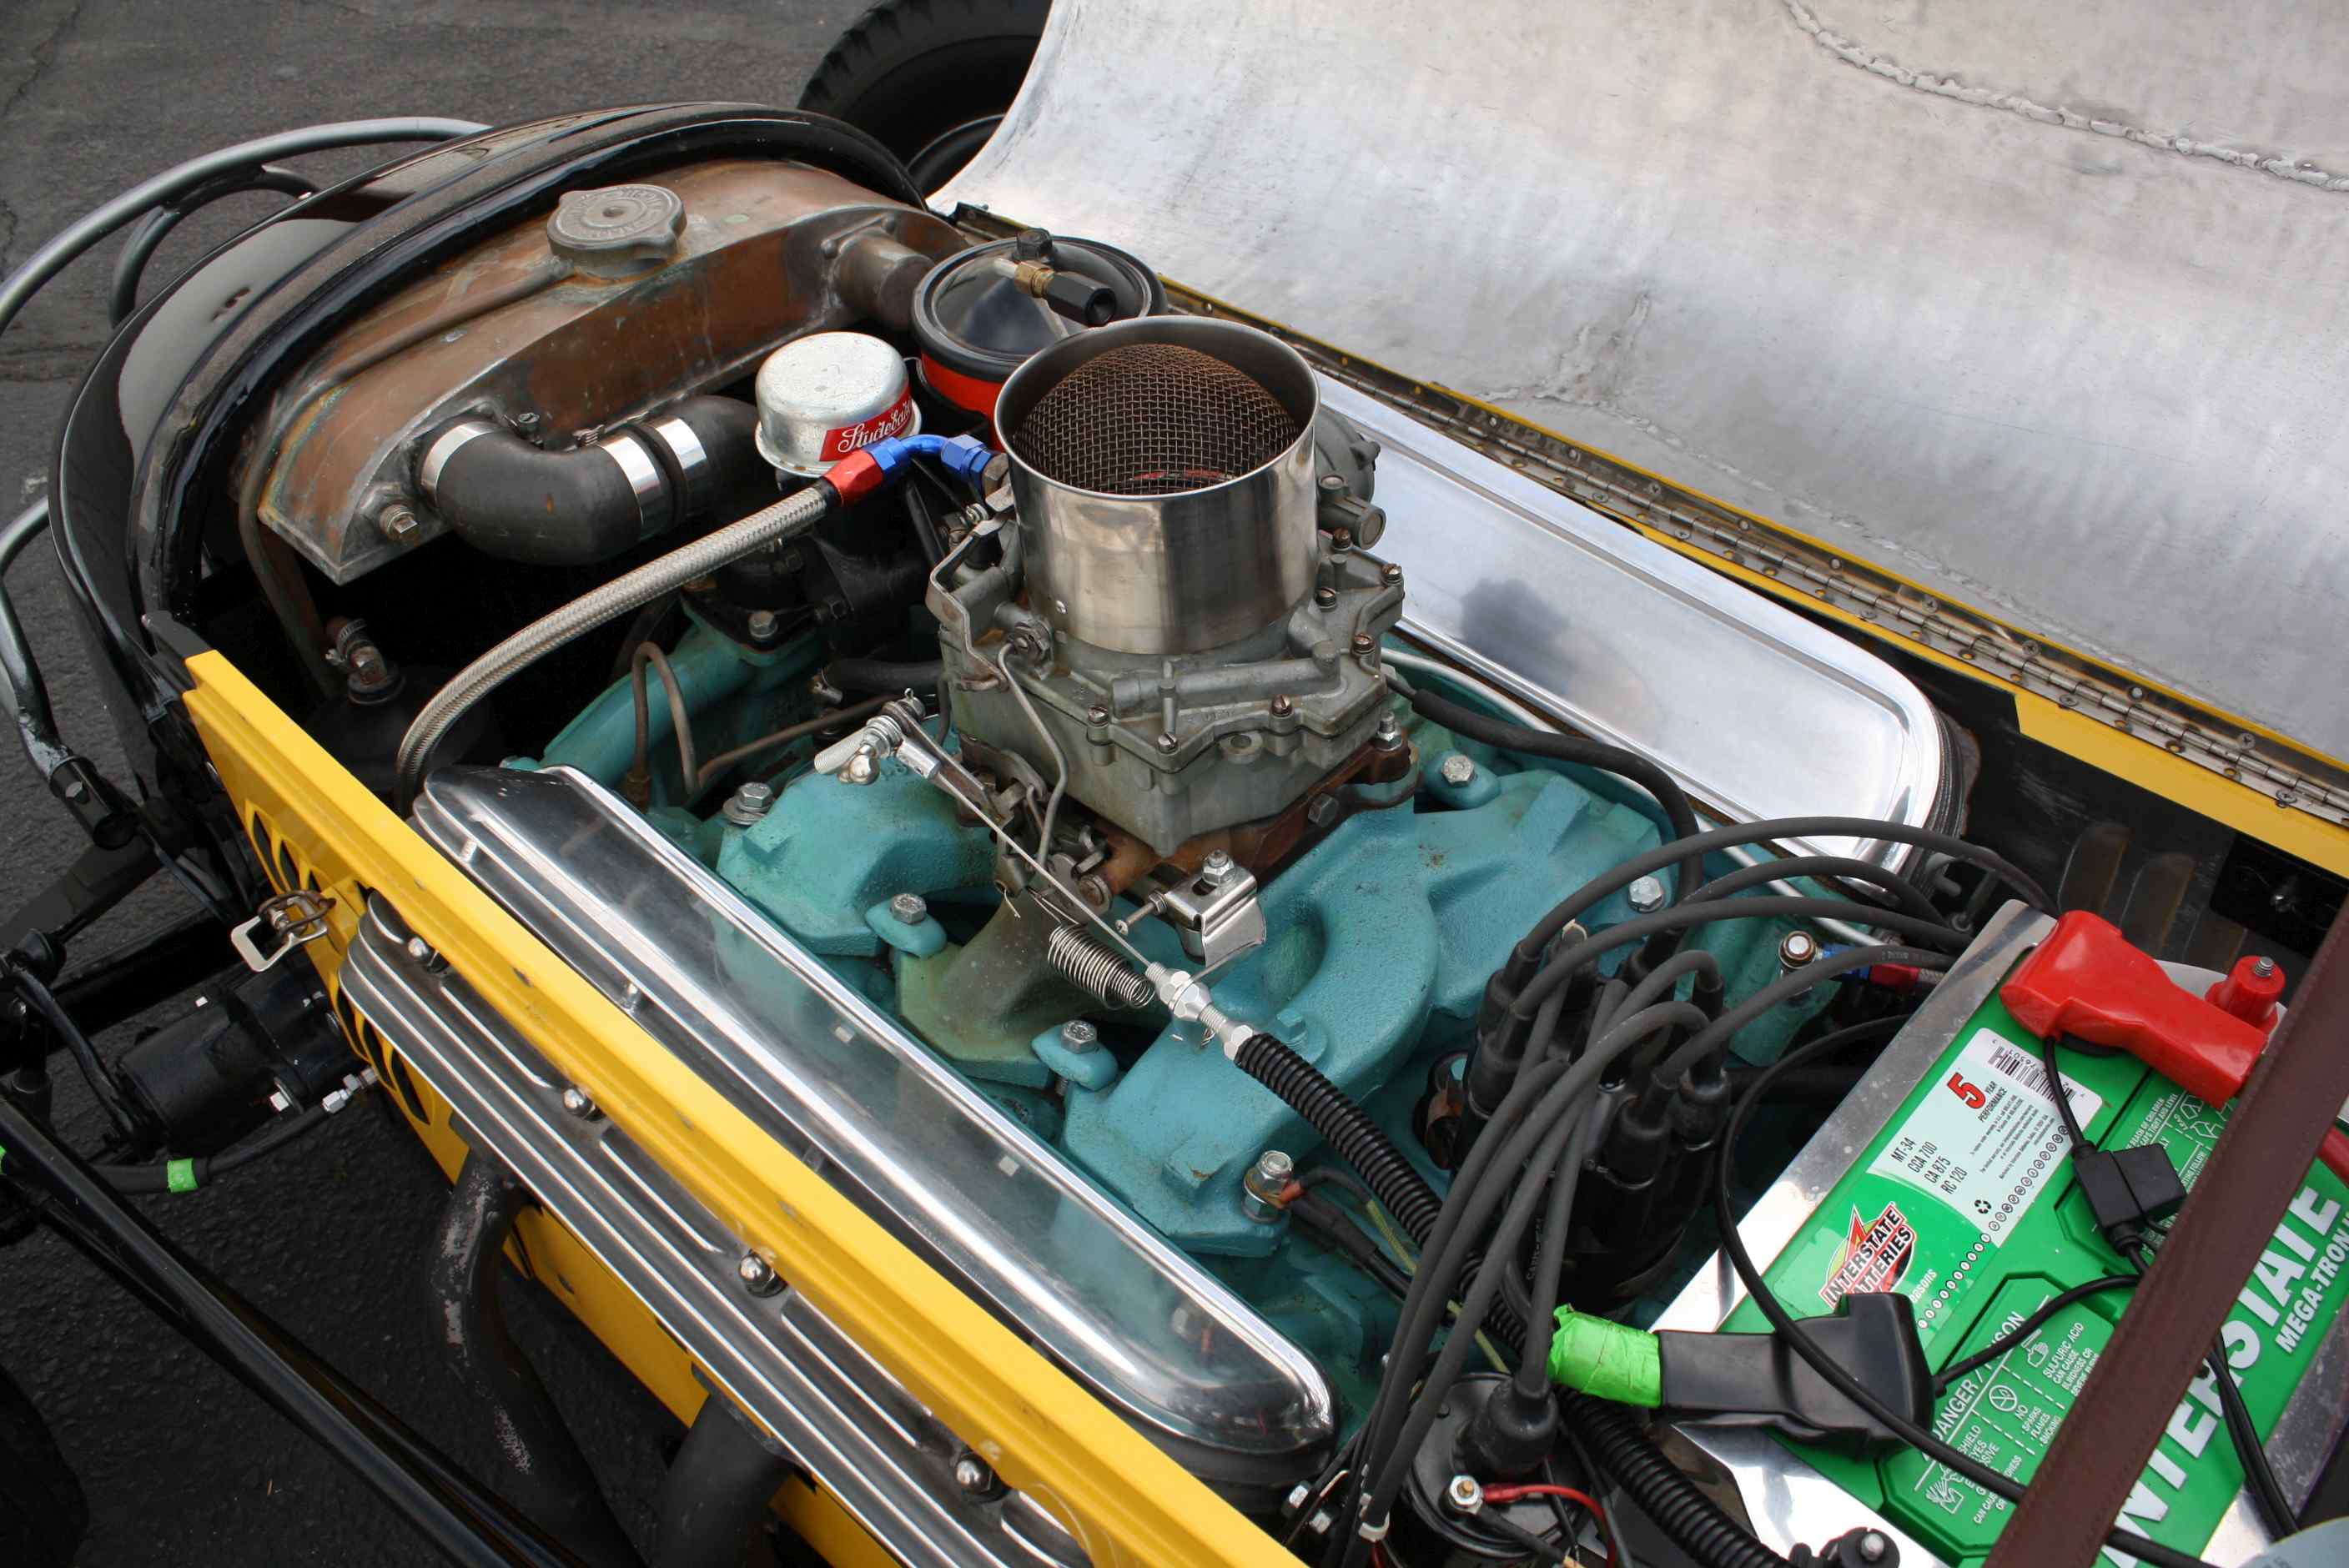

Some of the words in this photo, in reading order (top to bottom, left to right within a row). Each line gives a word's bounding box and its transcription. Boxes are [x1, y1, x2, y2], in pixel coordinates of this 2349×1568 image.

[1947, 1072, 1986, 1109] 5
[1985, 1081, 1998, 1095] YEAR
[1978, 1087, 2008, 1123] PERFORMANCE
[2145, 1098, 2164, 1122] CHILDREN
[2147, 1118, 2162, 1133] TIGHT
[2158, 1108, 2168, 1119] AND
[1891, 1137, 1916, 1163] MT-34
[1908, 1155, 1927, 1173] CCA
[1919, 1142, 1937, 1158] 700
[1924, 1170, 1940, 1184] CA
[1932, 1156, 1950, 1173] 875
[1940, 1181, 1957, 1194] RC
[1949, 1167, 1967, 1183] 120
[1824, 1209, 1900, 1303] INTERSTATE
[1854, 1226, 1912, 1294] ATTERIES
[1909, 1269, 1937, 1303] easons
[2275, 1228, 2349, 1354] MEGA-TRON
[2043, 1340, 2071, 1379] SULFURIC
[2068, 1323, 2084, 1342] ACID
[2053, 1368, 2065, 1385] CAN
[2062, 1349, 2079, 1371] CAUSE
[2062, 1357, 2086, 1390] BLINDNESS
[2015, 1405, 2029, 1420] NO
[2022, 1406, 2042, 1432] SPARKS
[2031, 1413, 2050, 1439] FLAMES
[1956, 1425, 1981, 1454] SHIELD
[1974, 1508, 1986, 1524] CAN
[1982, 1491, 1999, 1510] CAUS
